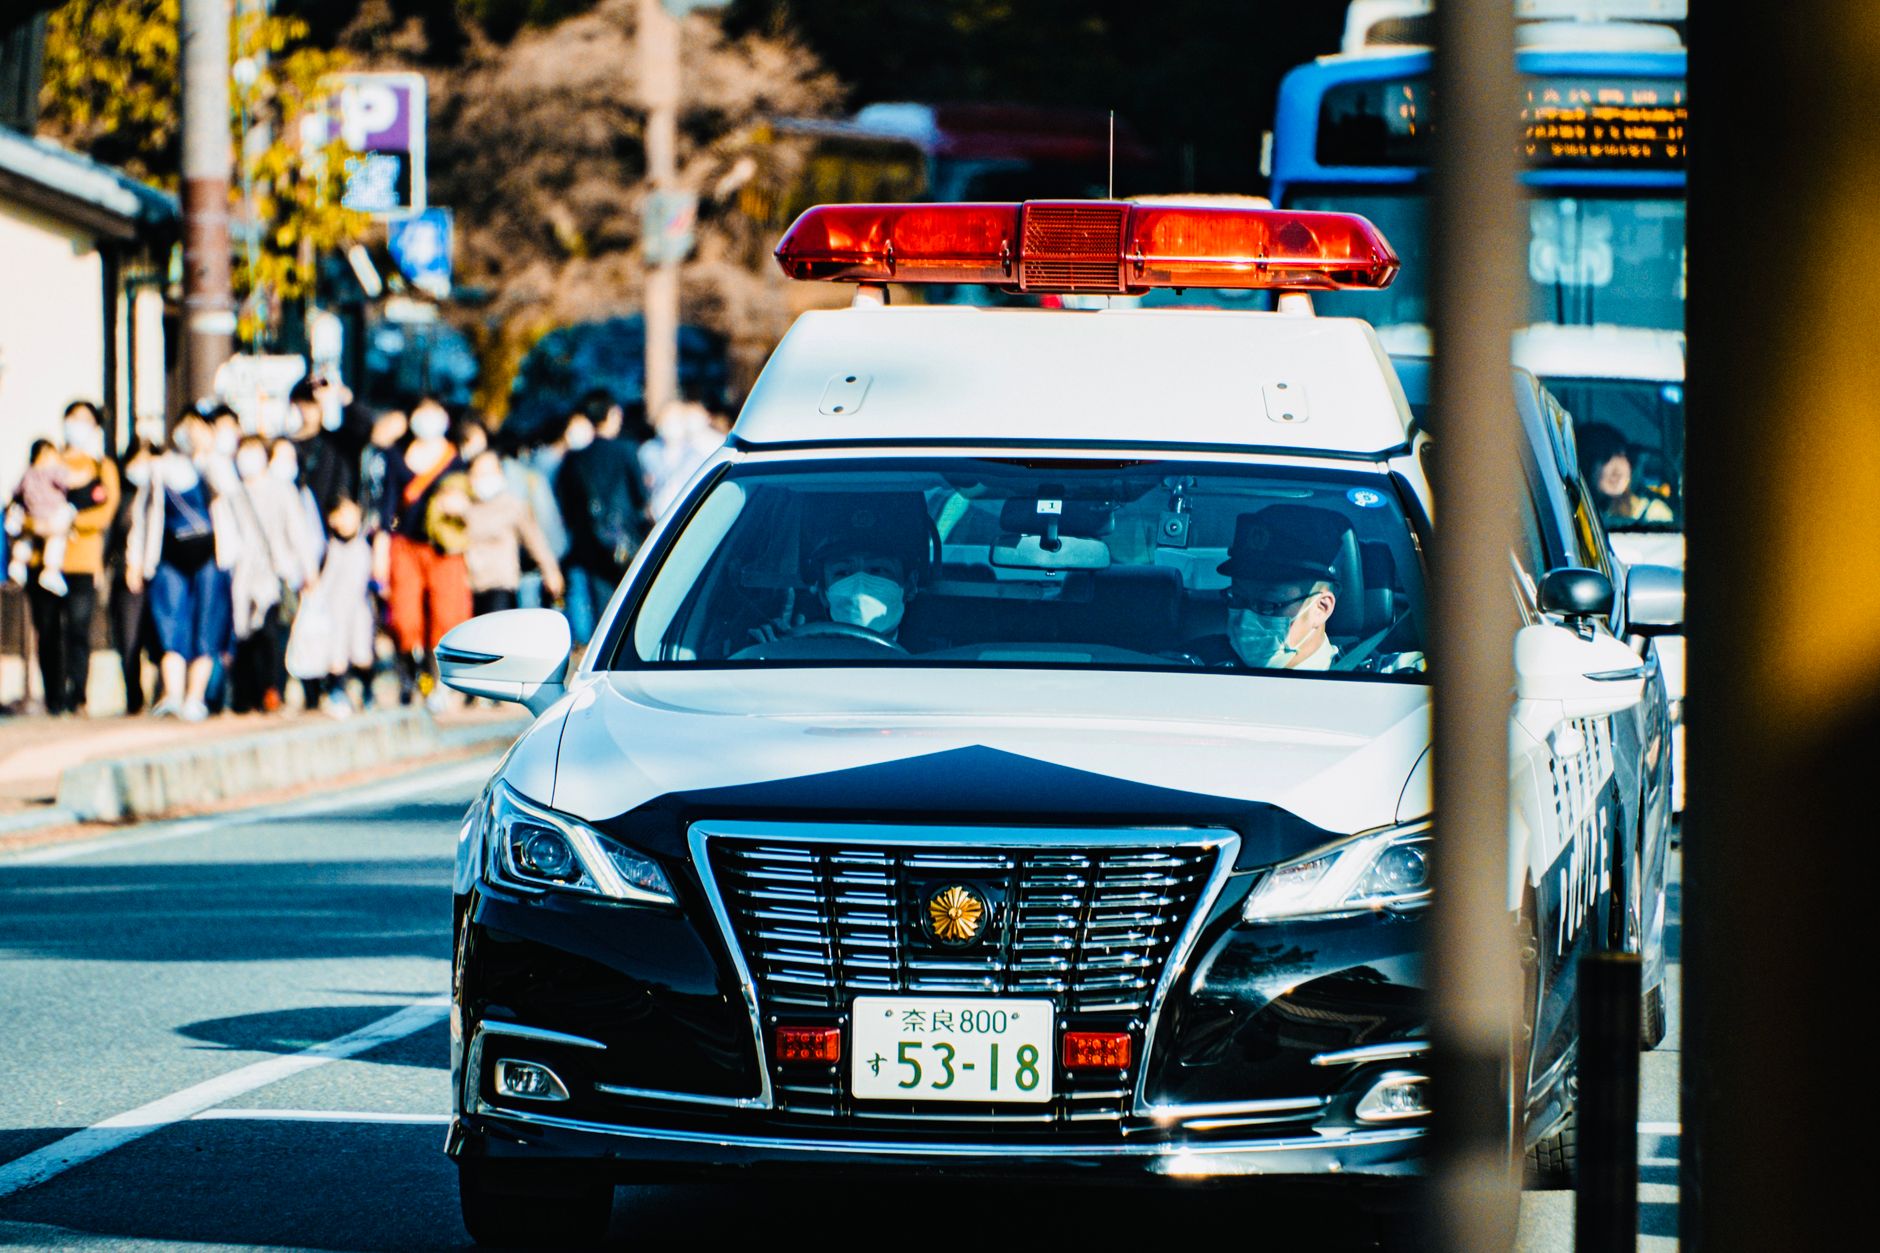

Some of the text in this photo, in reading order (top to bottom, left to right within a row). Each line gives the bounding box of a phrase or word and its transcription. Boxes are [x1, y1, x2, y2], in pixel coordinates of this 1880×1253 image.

[341, 85, 398, 151] P
[867, 1041, 1040, 1092] す 53-18
